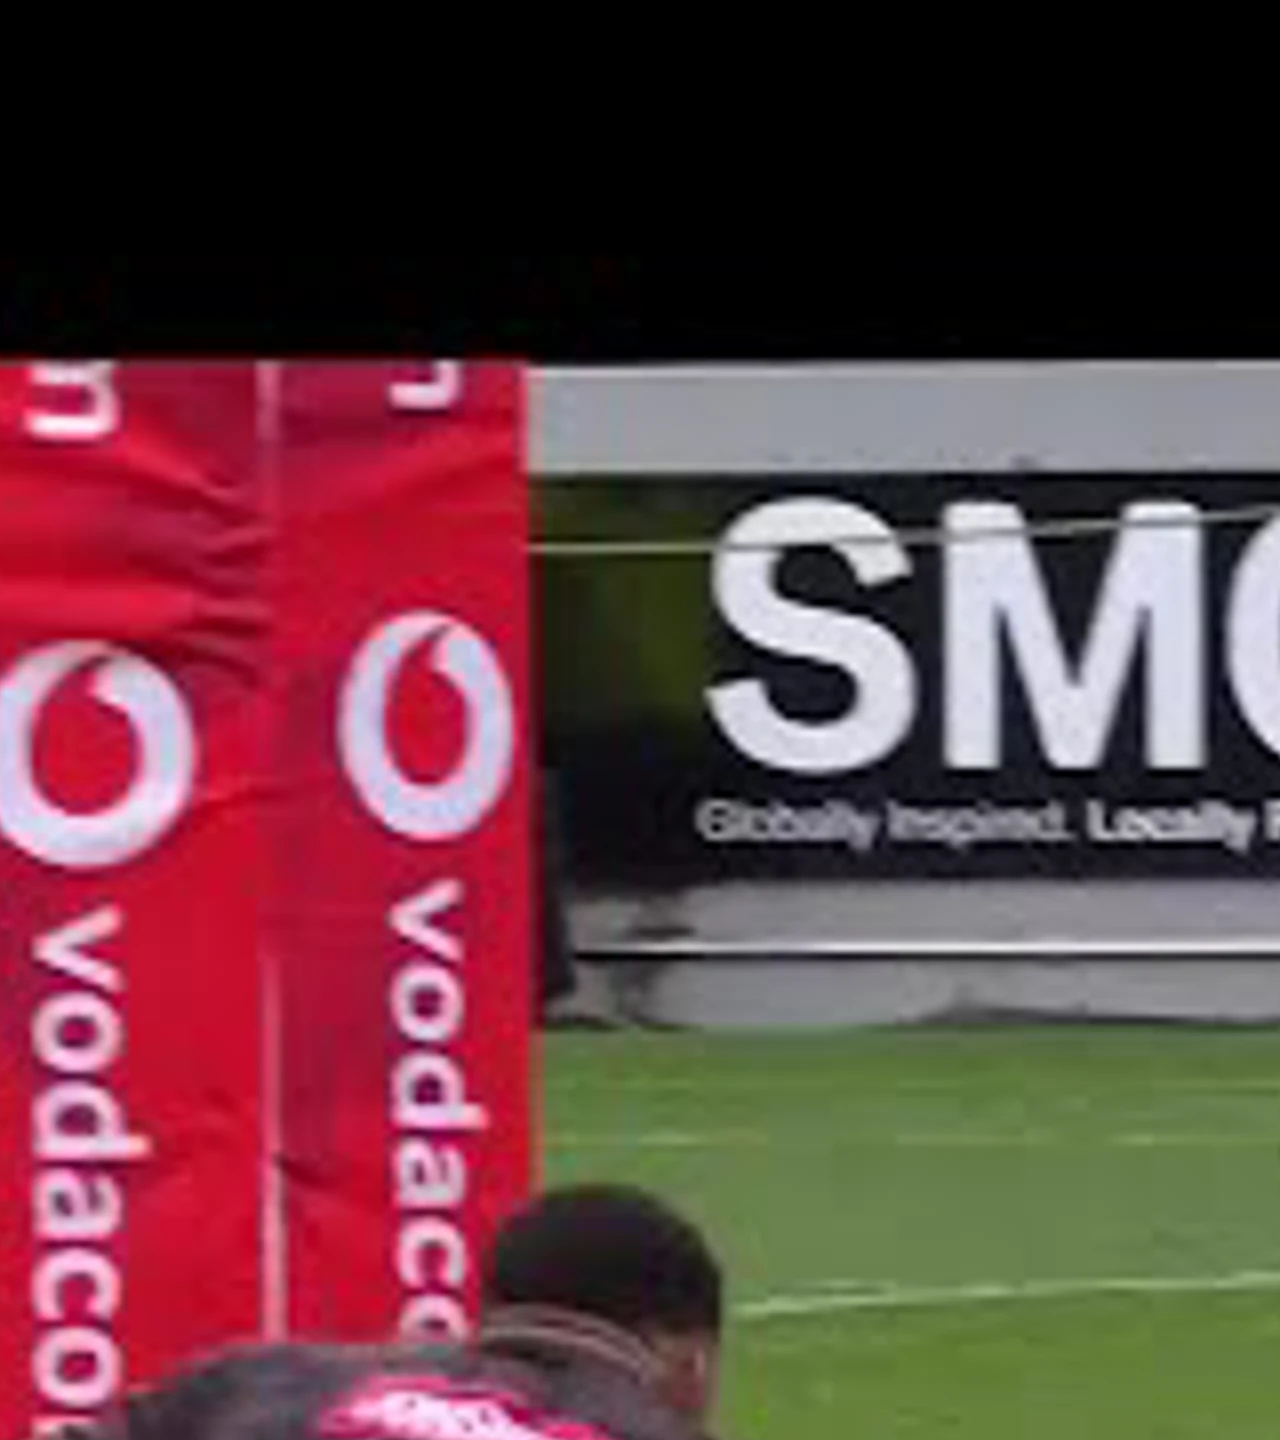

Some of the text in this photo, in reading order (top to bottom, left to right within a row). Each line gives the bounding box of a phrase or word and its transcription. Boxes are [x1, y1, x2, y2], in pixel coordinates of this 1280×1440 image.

[695, 798, 880, 853] Globally
[1085, 798, 1256, 853] Locally
[31, 903, 153, 1438] vodaco
[389, 876, 489, 1344] vodaco
